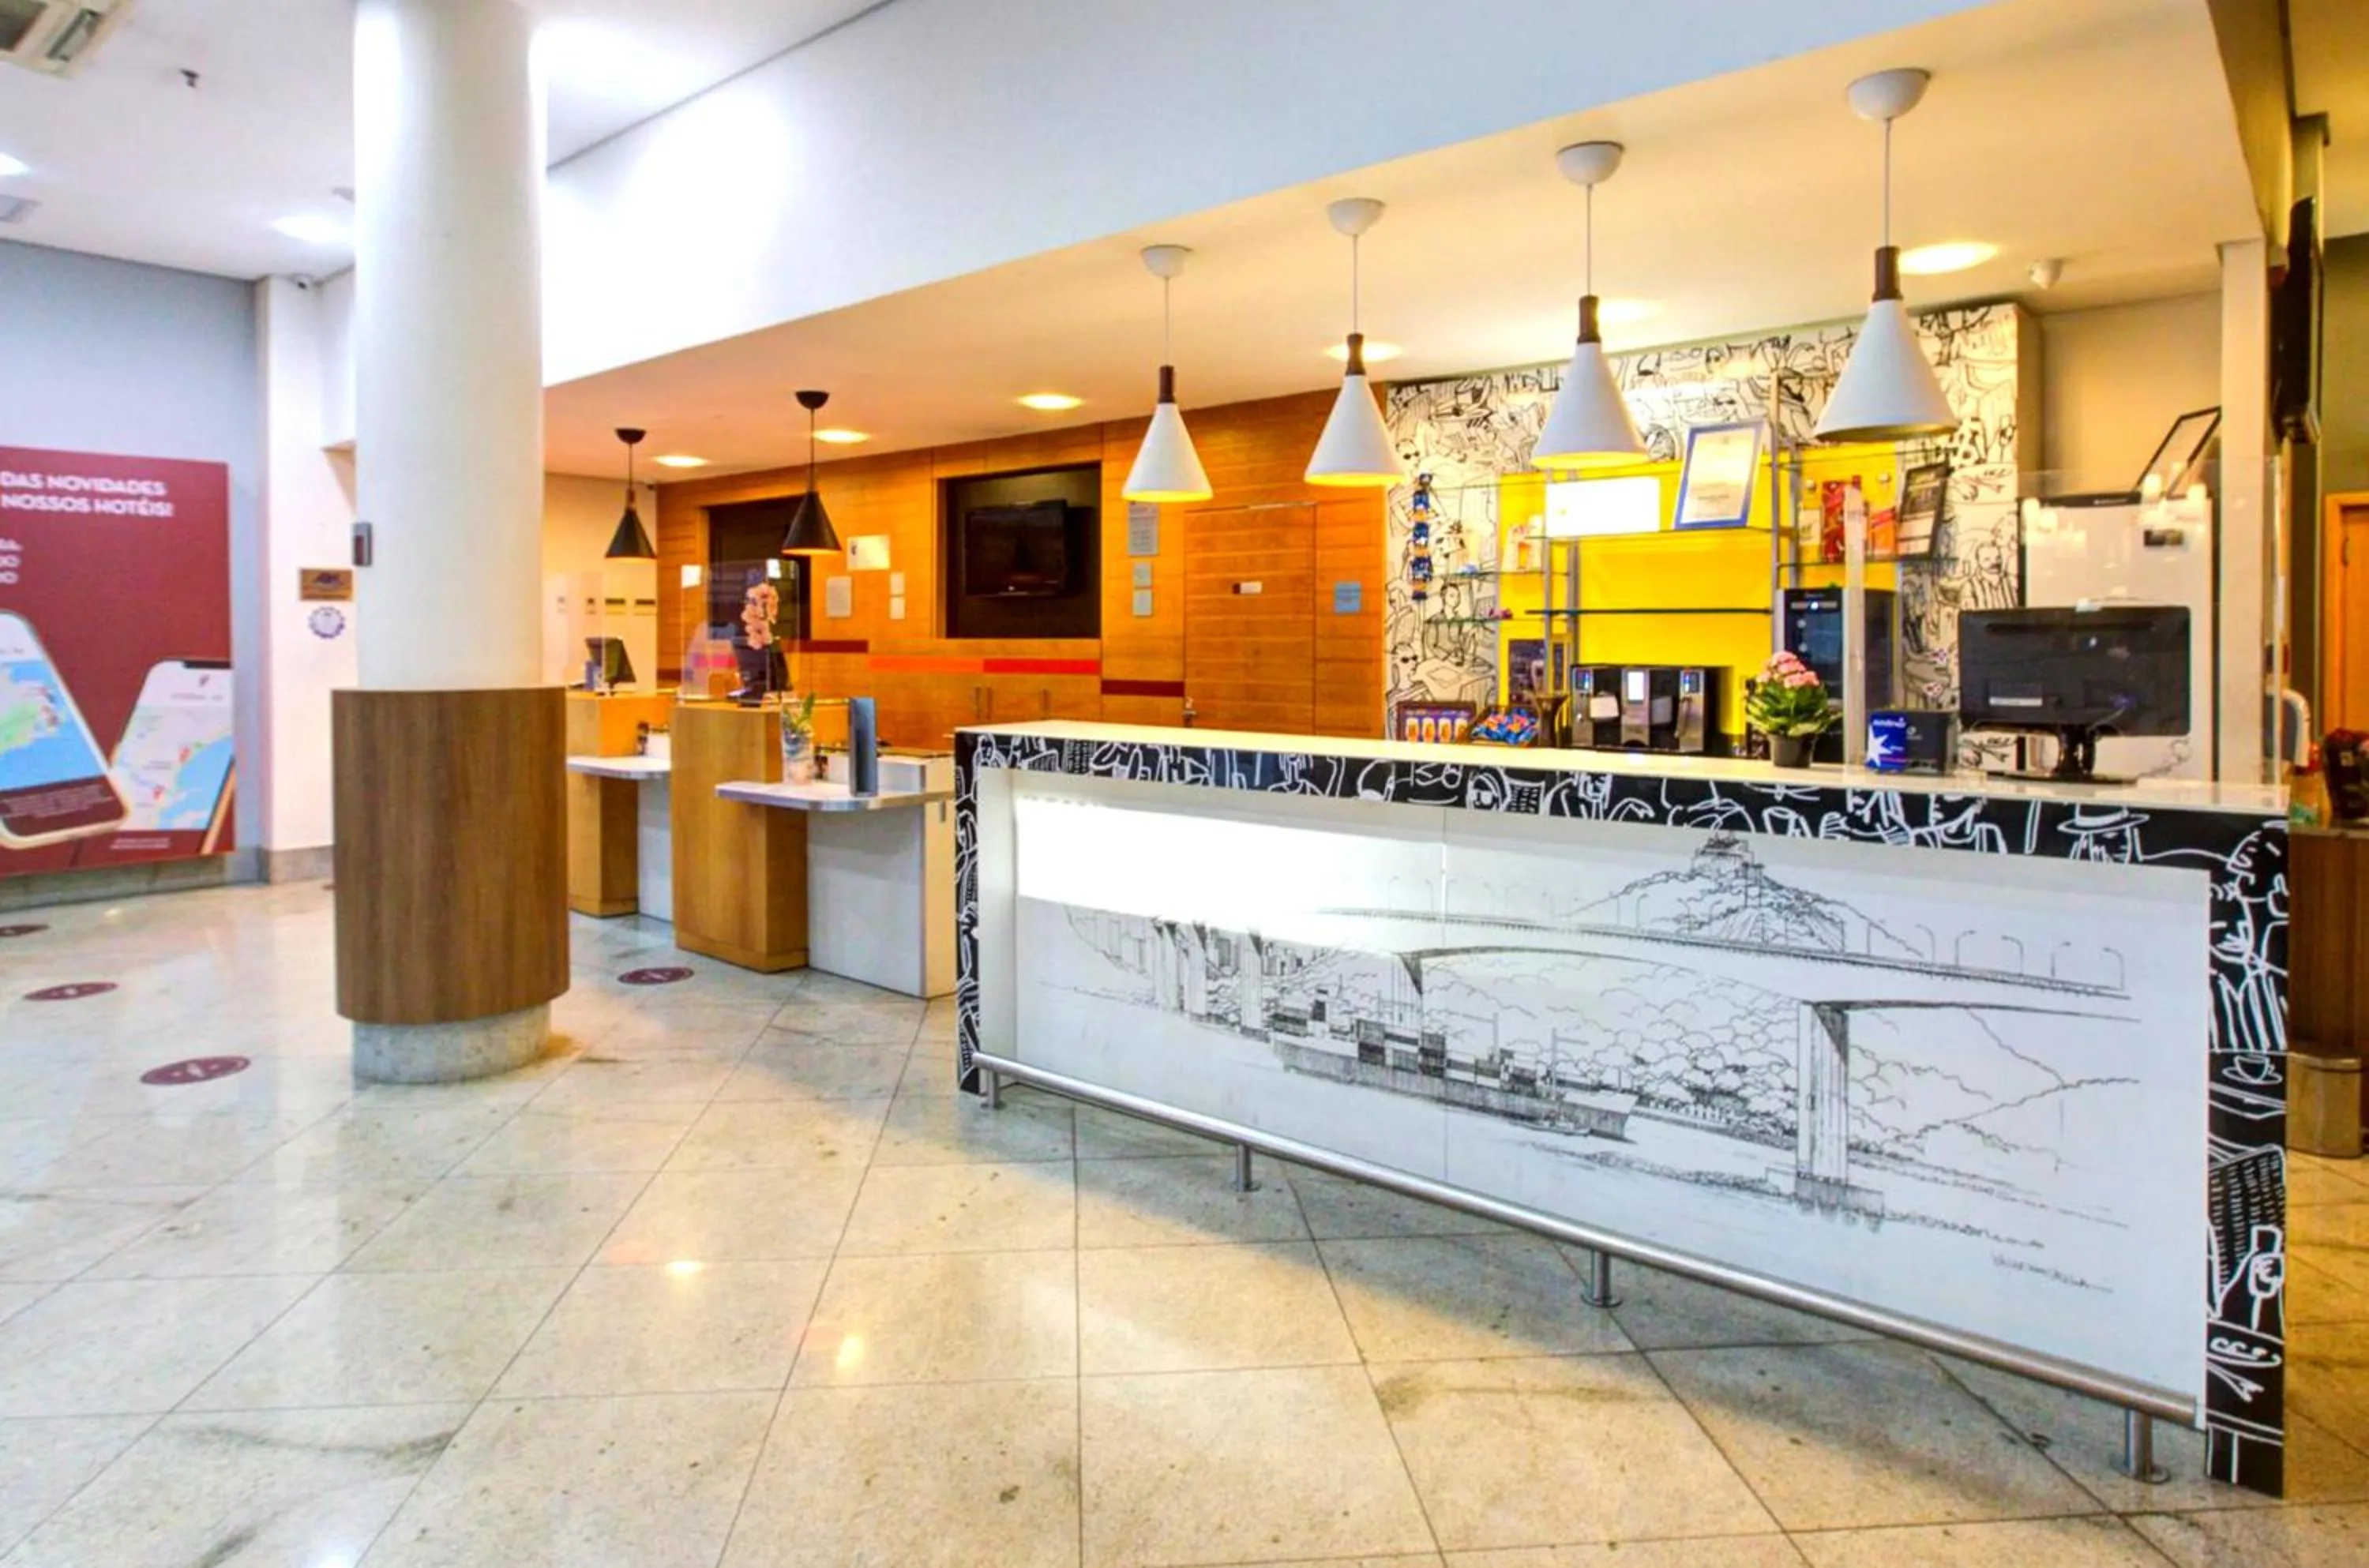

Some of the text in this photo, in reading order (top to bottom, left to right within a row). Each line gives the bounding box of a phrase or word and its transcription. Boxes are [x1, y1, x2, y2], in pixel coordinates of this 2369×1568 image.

[0, 471, 167, 496] DAS NOVIDADES
[1, 493, 92, 512] NOSSOS
